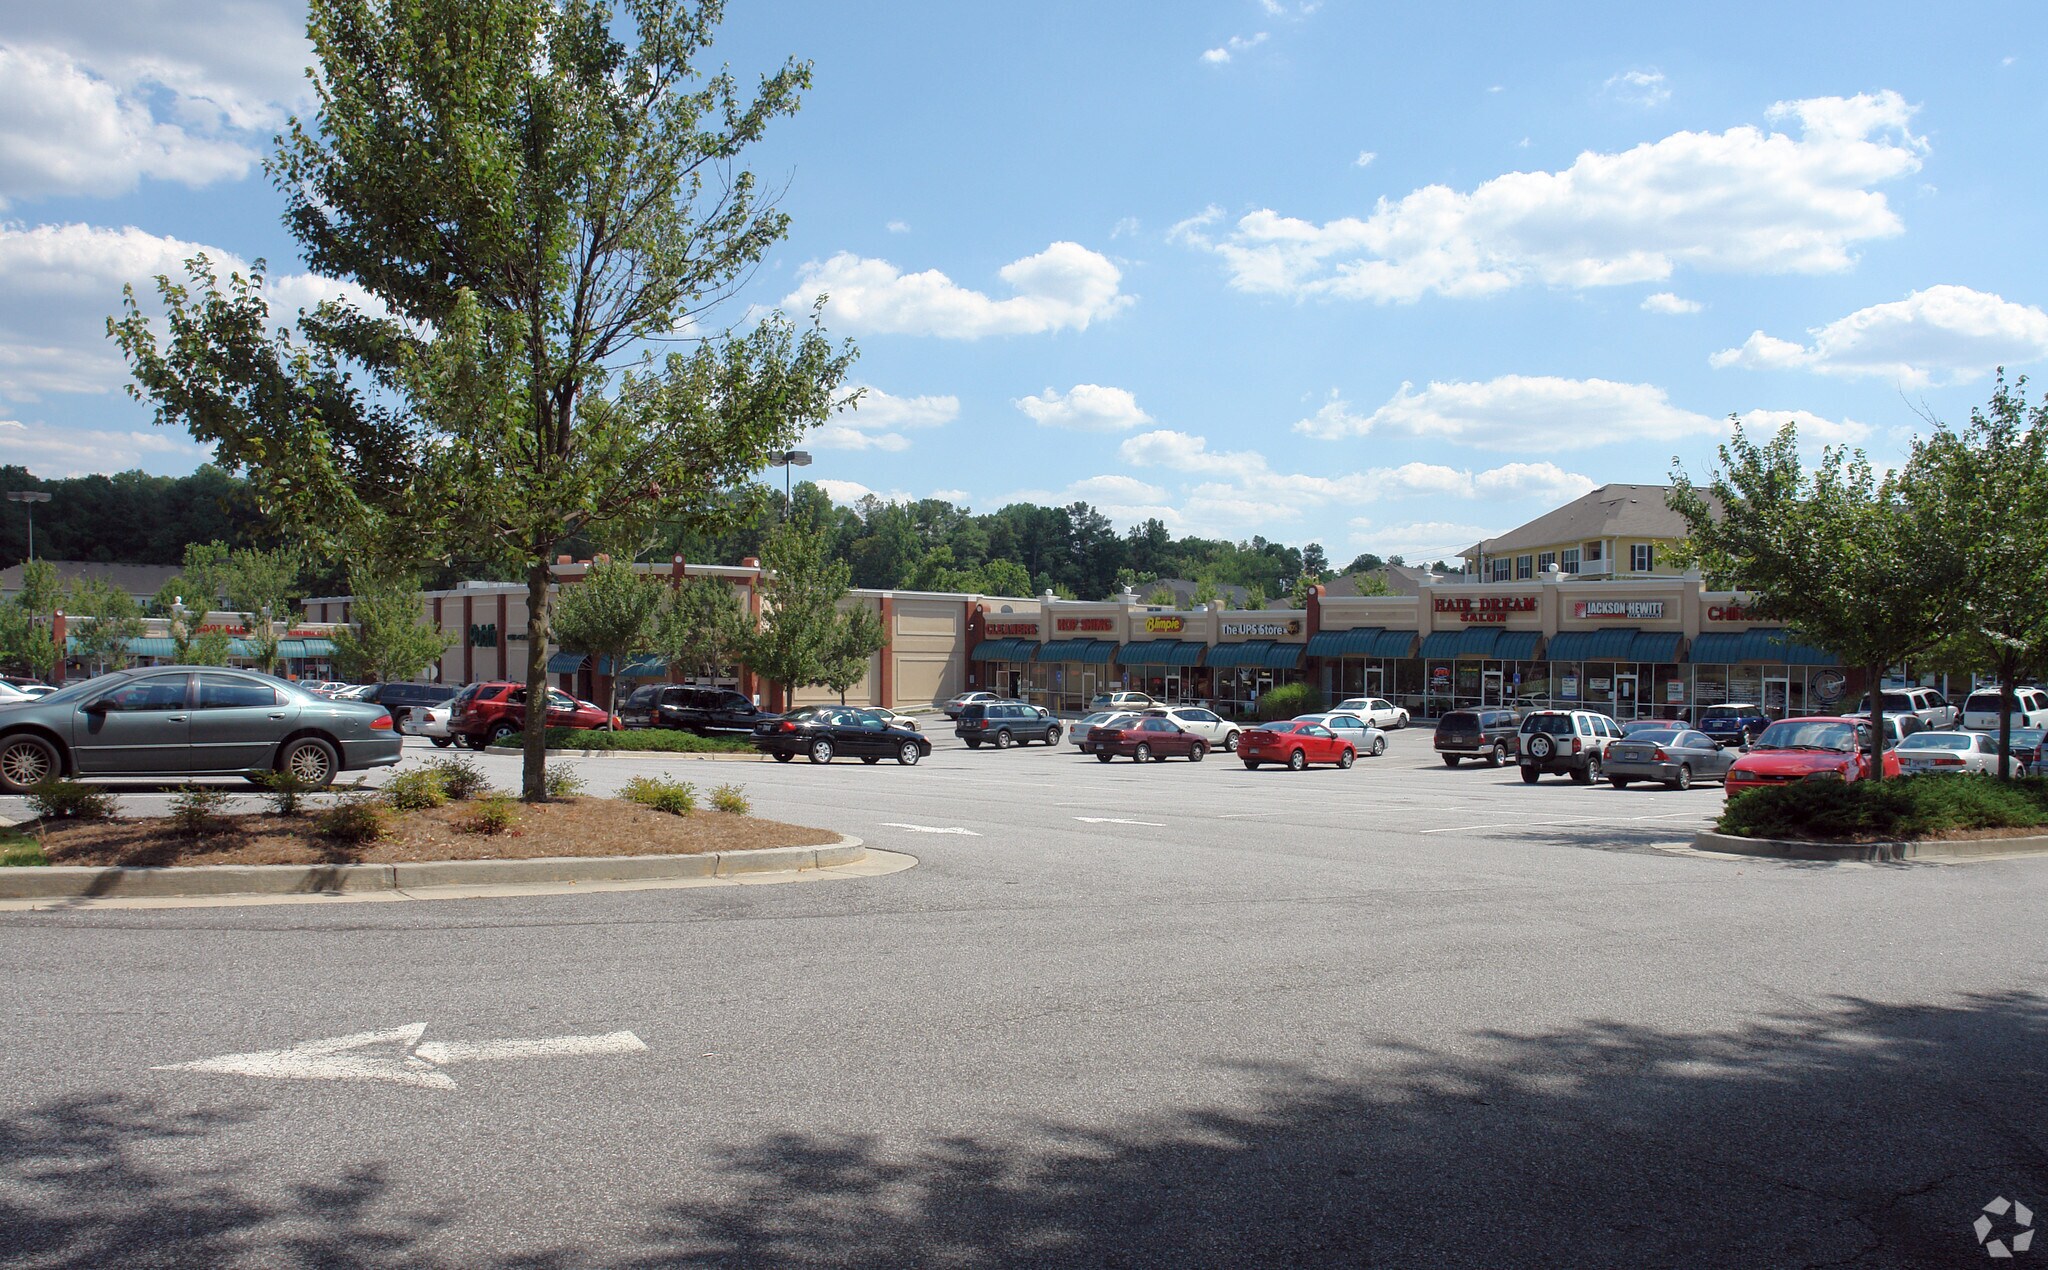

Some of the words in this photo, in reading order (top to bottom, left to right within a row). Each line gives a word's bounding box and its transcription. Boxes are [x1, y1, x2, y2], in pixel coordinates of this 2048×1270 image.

[1435, 598, 1472, 612] HAIR
[1479, 597, 1537, 612] DREAM
[1587, 602, 1626, 614] JACKSON
[1628, 602, 1663, 614] HEWITT
[1145, 616, 1181, 632] Blimpie
[1460, 613, 1506, 623] SALON
[986, 623, 1039, 635] CLEANERS
[1222, 624, 1239, 635] The
[1241, 624, 1257, 635] UPS
[1259, 624, 1284, 635] Store
